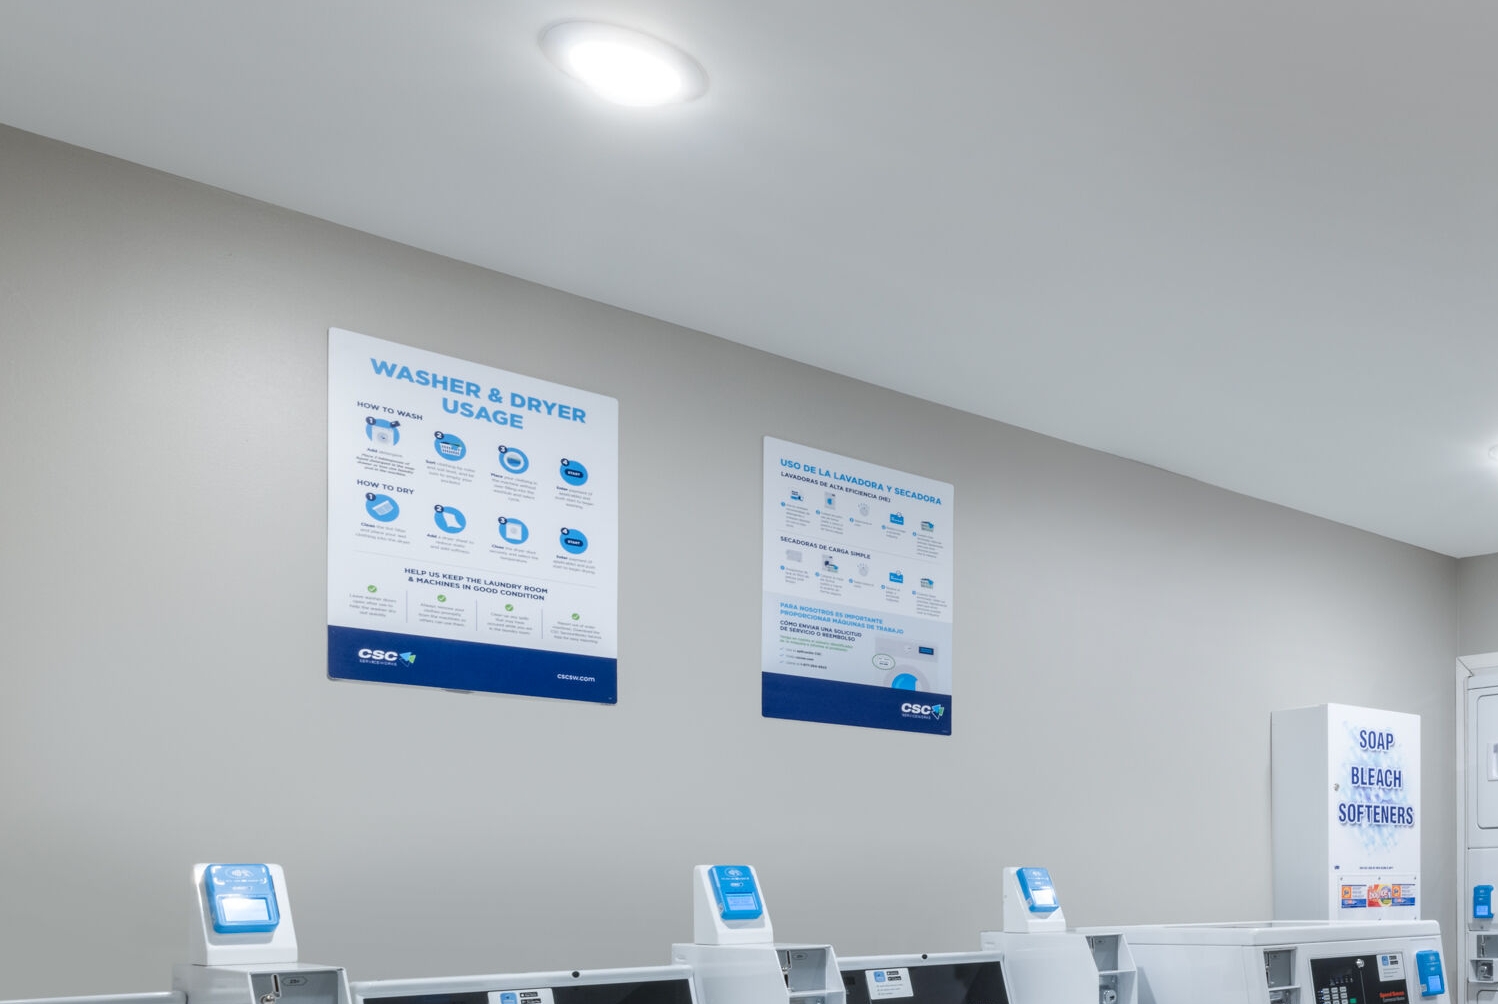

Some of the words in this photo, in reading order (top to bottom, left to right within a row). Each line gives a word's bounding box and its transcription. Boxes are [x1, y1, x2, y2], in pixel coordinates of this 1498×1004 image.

[370, 357, 481, 399] WASHER
[488, 388, 503, 403] &
[511, 392, 586, 424] DRYER
[357, 401, 380, 411] HOW
[383, 406, 394, 414] TO
[397, 410, 423, 421] WASH
[442, 397, 524, 429] USAGE
[356, 479, 380, 489] HOW
[382, 483, 394, 492] TO
[397, 486, 415, 495] DRY
[780, 458, 801, 470] USO
[803, 464, 816, 474] DE
[819, 468, 831, 478] LA
[833, 472, 884, 491] LAVADORA
[887, 485, 892, 493] Y
[894, 487, 942, 506] SECADORA
[781, 471, 819, 485] LAVADORAS
[820, 480, 829, 488] DE
[830, 482, 844, 491] ALTA
[845, 486, 877, 499] EFICIENCIA
[878, 494, 891, 503] (HE)
[780, 536, 818, 549] SECADORAS
[819, 543, 827, 551] DE
[828, 545, 849, 556] CARGA
[850, 550, 871, 560] SIMPLE
[404, 567, 427, 576] HELP
[429, 571, 440, 579] US
[442, 573, 464, 582] KEEP
[466, 576, 482, 584] THE
[483, 579, 522, 591] LAUNDRY
[524, 585, 548, 594] ROOM
[416, 577, 460, 589] MACHINES
[473, 585, 498, 595] GOOD
[500, 588, 545, 601] CONDITION
[780, 602, 798, 611] PARA
[800, 605, 834, 617] NOSOTROS
[844, 613, 883, 625] IMPORTANTE
[780, 609, 831, 625] PROPORCIONAR
[876, 625, 904, 635] TRABAJO
[780, 619, 797, 628] CÓMO
[799, 623, 819, 632] ENVIAR
[834, 627, 862, 638] SOLICITUD
[789, 627, 815, 637] SERVICIO
[822, 632, 856, 642] REEMBOLSO
[358, 648, 398, 661] CSC
[557, 673, 596, 682] cscsw.com
[901, 702, 931, 715] CSC
[1359, 729, 1394, 750] SOAP
[1351, 766, 1402, 788] BLEACH
[1338, 803, 1414, 825] SOFTENERS
